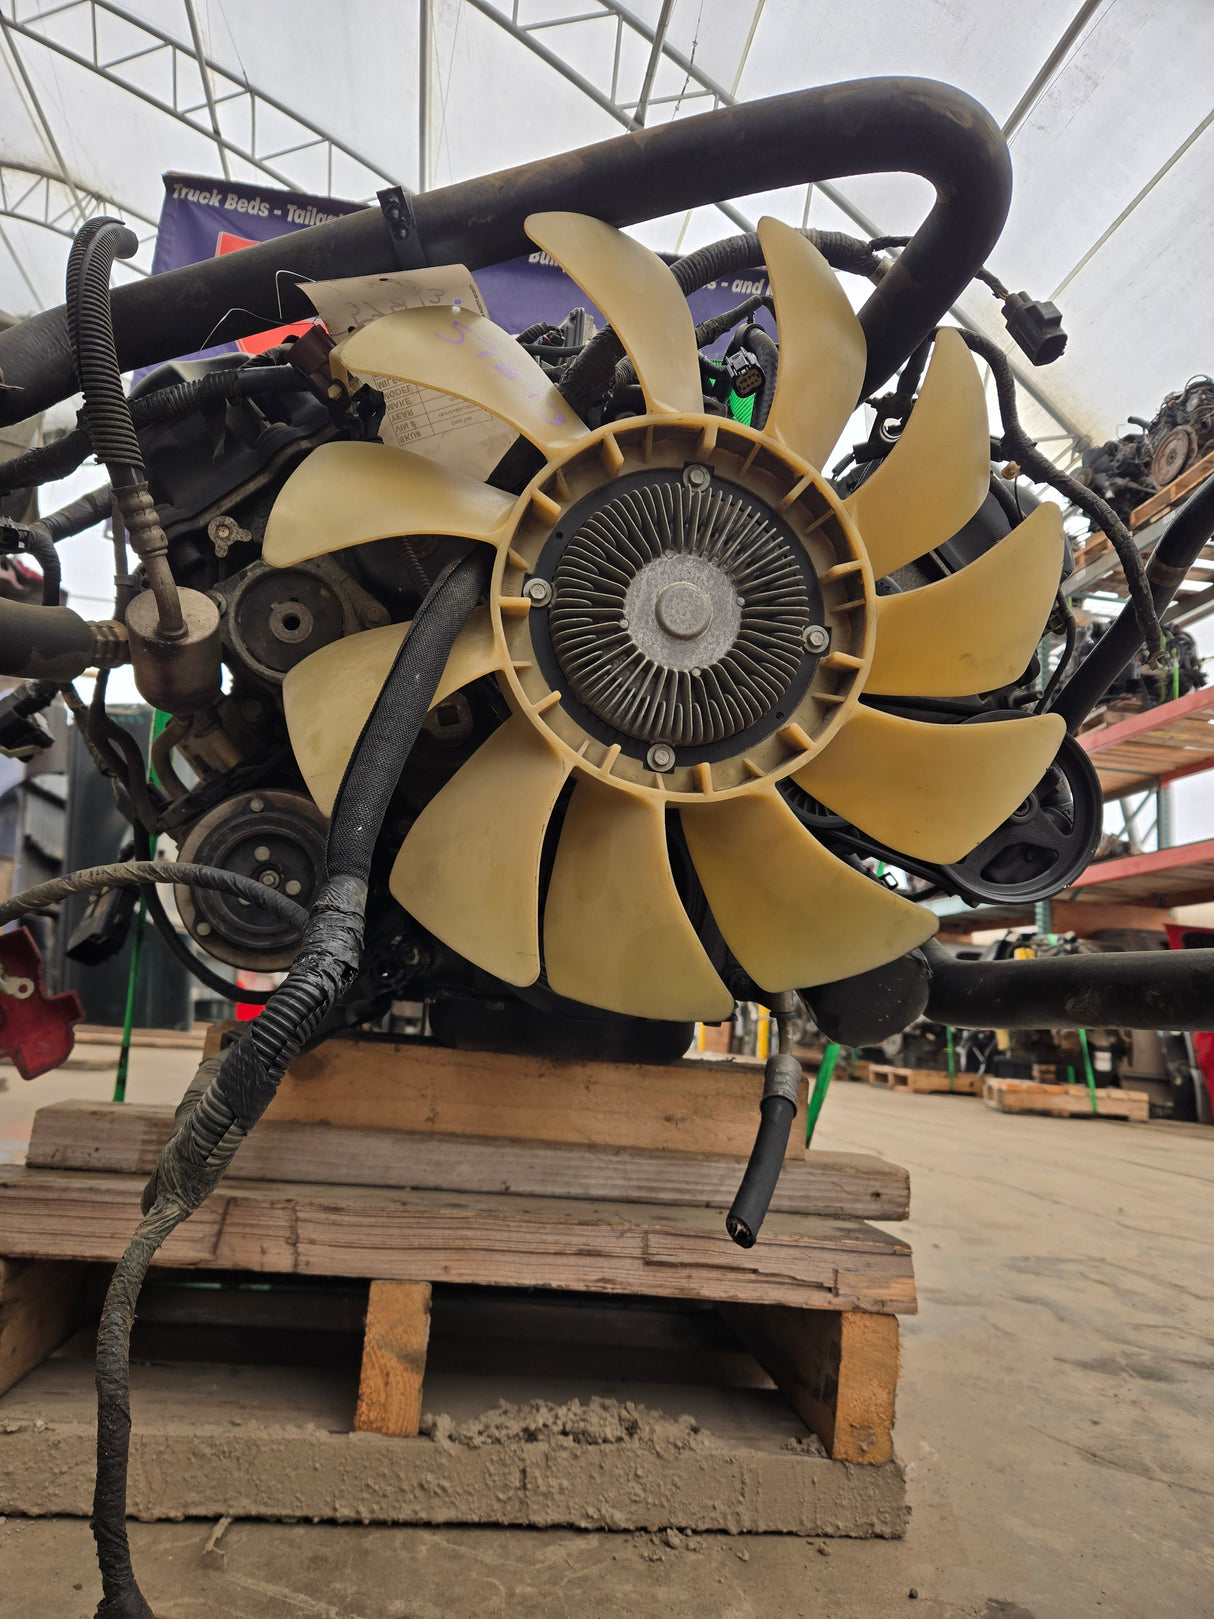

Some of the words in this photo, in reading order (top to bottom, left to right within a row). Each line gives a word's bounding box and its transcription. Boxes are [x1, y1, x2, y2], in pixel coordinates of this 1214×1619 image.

[172, 183, 222, 208] Truck
[224, 193, 269, 217] Beds
[731, 279, 766, 295] and
